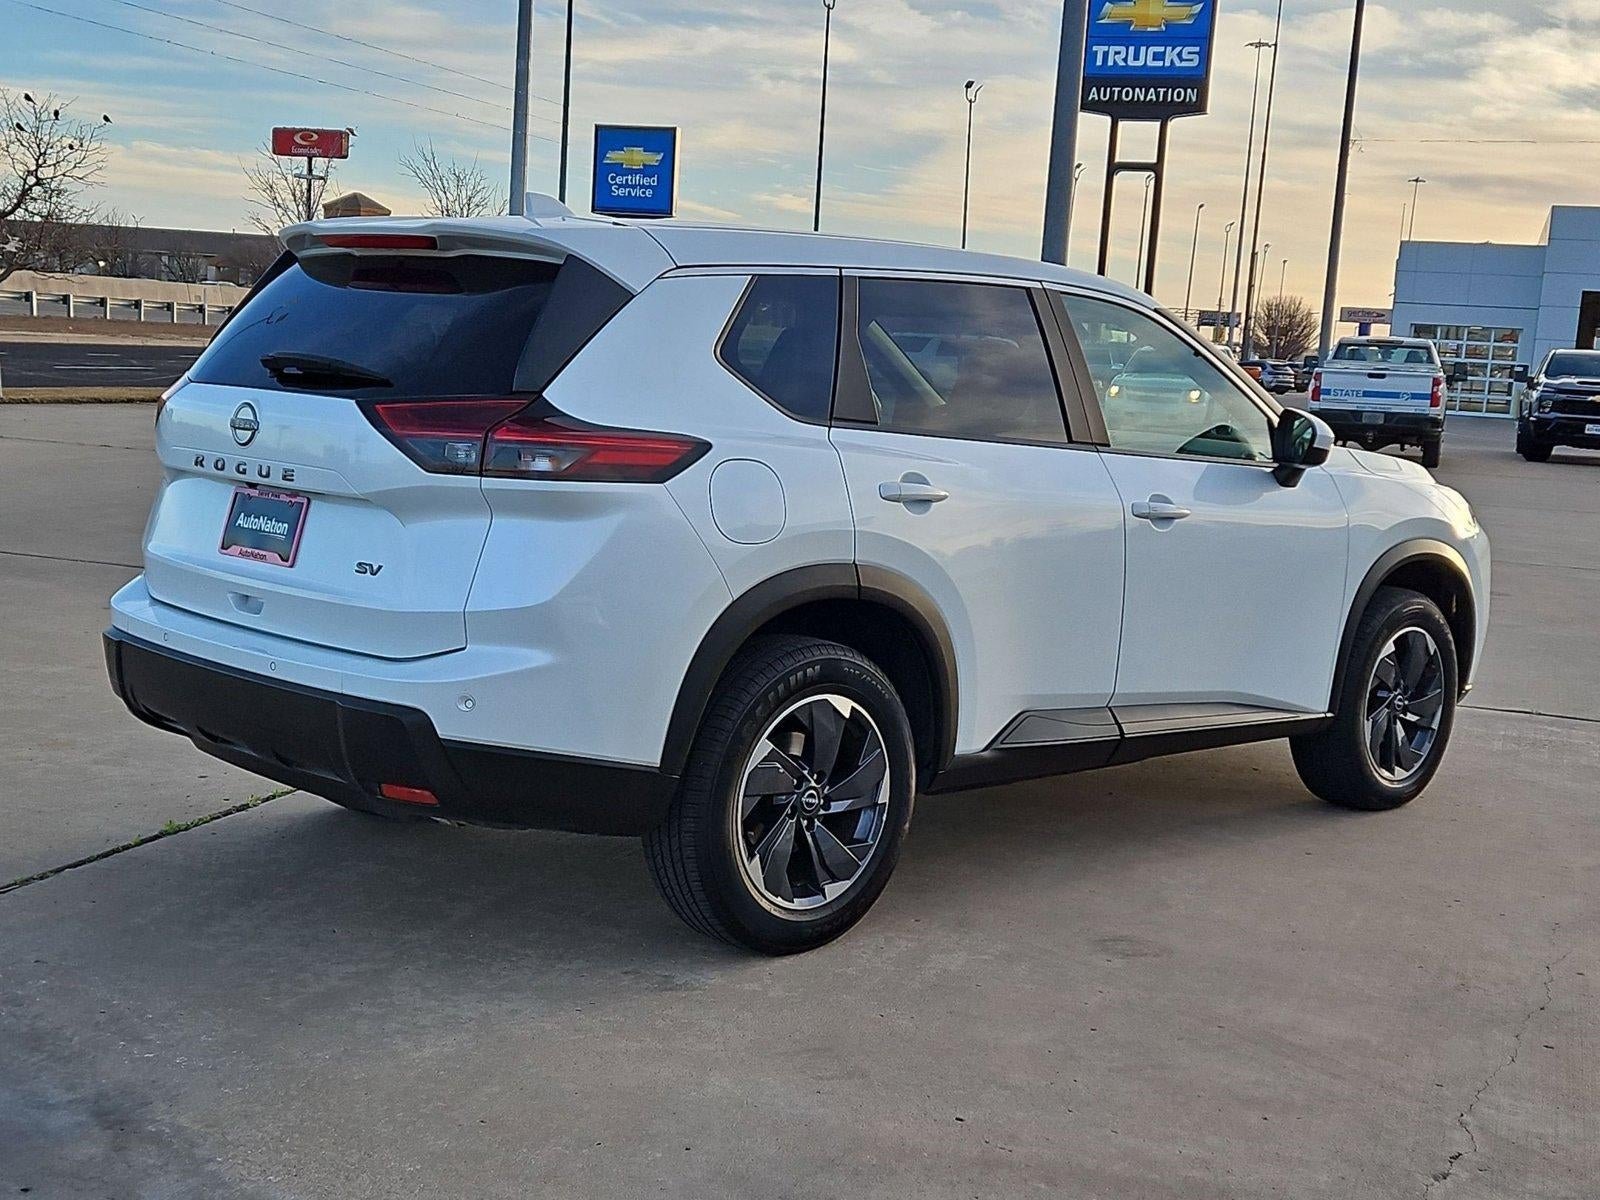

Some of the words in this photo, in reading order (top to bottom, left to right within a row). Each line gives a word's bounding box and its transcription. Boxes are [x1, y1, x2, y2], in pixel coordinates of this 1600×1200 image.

[1092, 45, 1200, 67] TRUCKS
[1088, 86, 1198, 102] AUTONATION
[608, 173, 658, 185] Certified
[611, 185, 653, 197] Service
[1332, 388, 1363, 398] STATE
[193, 454, 295, 482] ROGUE
[235, 512, 289, 535] AutoNation
[238, 548, 267, 560] AutoNation
[355, 562, 384, 576] SV
